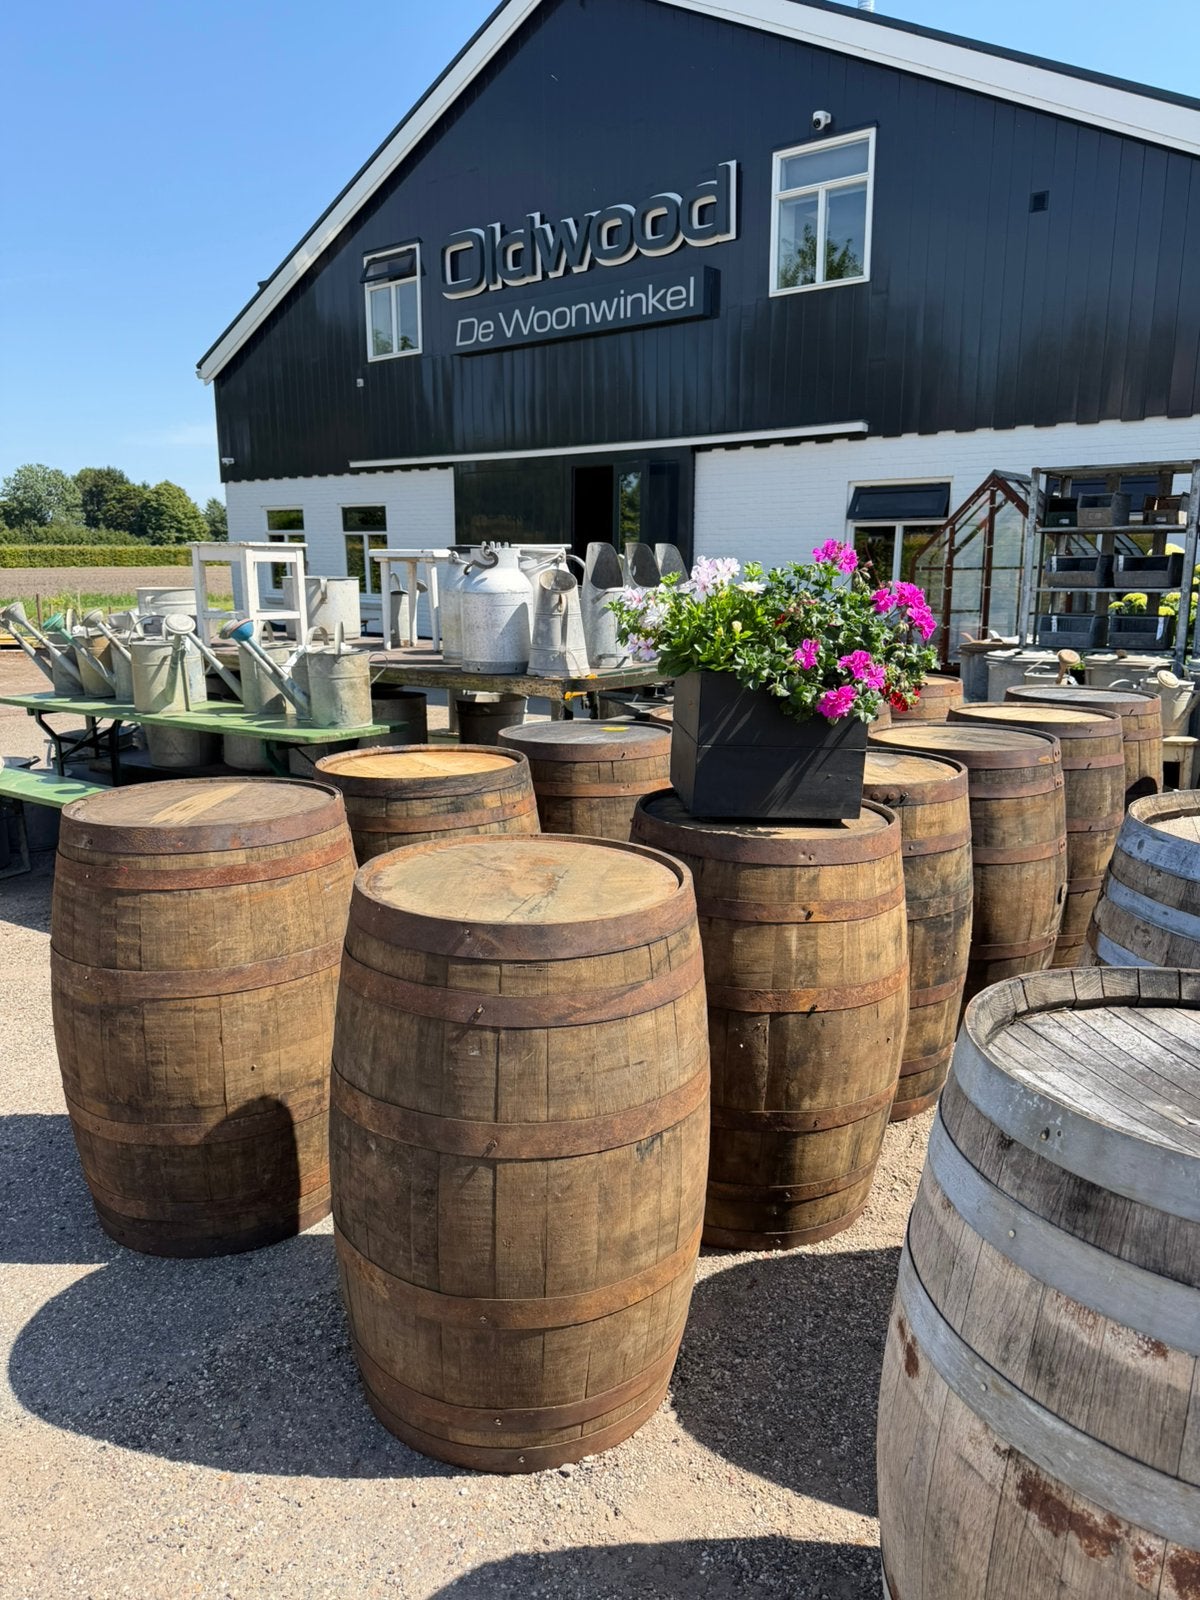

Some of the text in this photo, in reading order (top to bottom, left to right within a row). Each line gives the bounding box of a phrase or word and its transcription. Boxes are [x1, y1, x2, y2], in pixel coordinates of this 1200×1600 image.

[441, 160, 738, 300] Oldwood
[455, 276, 695, 347] De Woonwinkel
